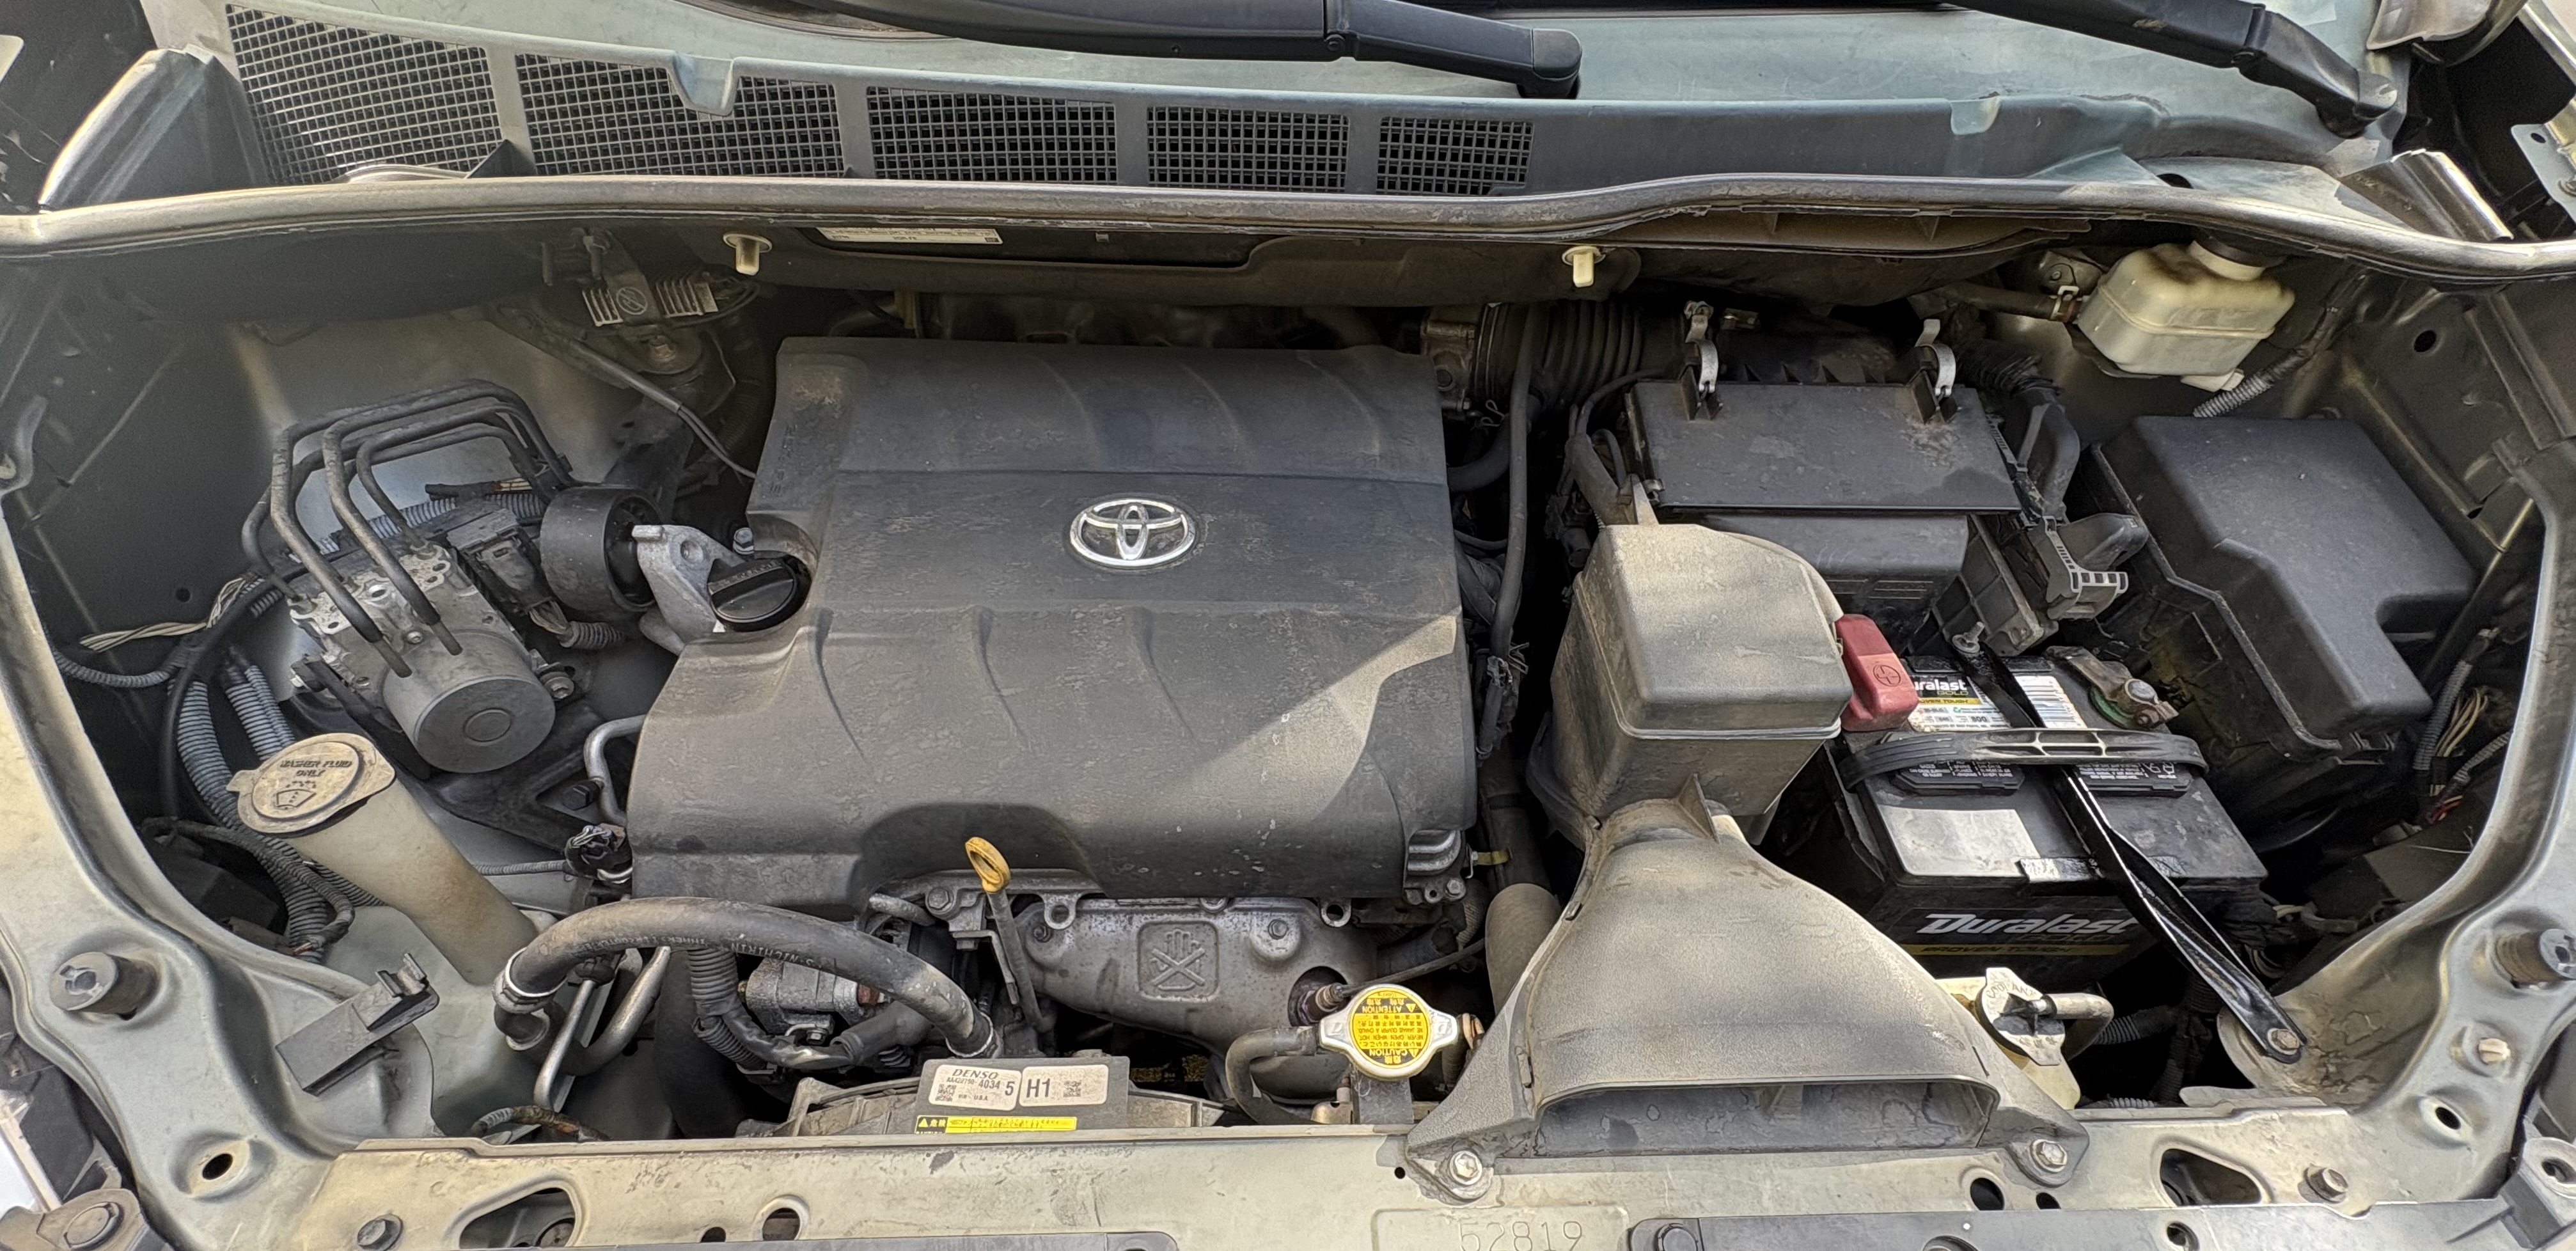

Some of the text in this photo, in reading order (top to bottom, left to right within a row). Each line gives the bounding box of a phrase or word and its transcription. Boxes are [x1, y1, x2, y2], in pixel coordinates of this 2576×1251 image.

[1914, 679, 1968, 691] ralast
[279, 760, 321, 768] WASHER
[1916, 913, 2140, 934] Duralast
[1362, 1005, 1402, 1014] ATTENTION
[952, 1069, 999, 1080] DENSO
[1005, 1081, 1016, 1096] 5
[1026, 1078, 1051, 1099] H1
[1457, 1220, 1583, 1251] 52819
